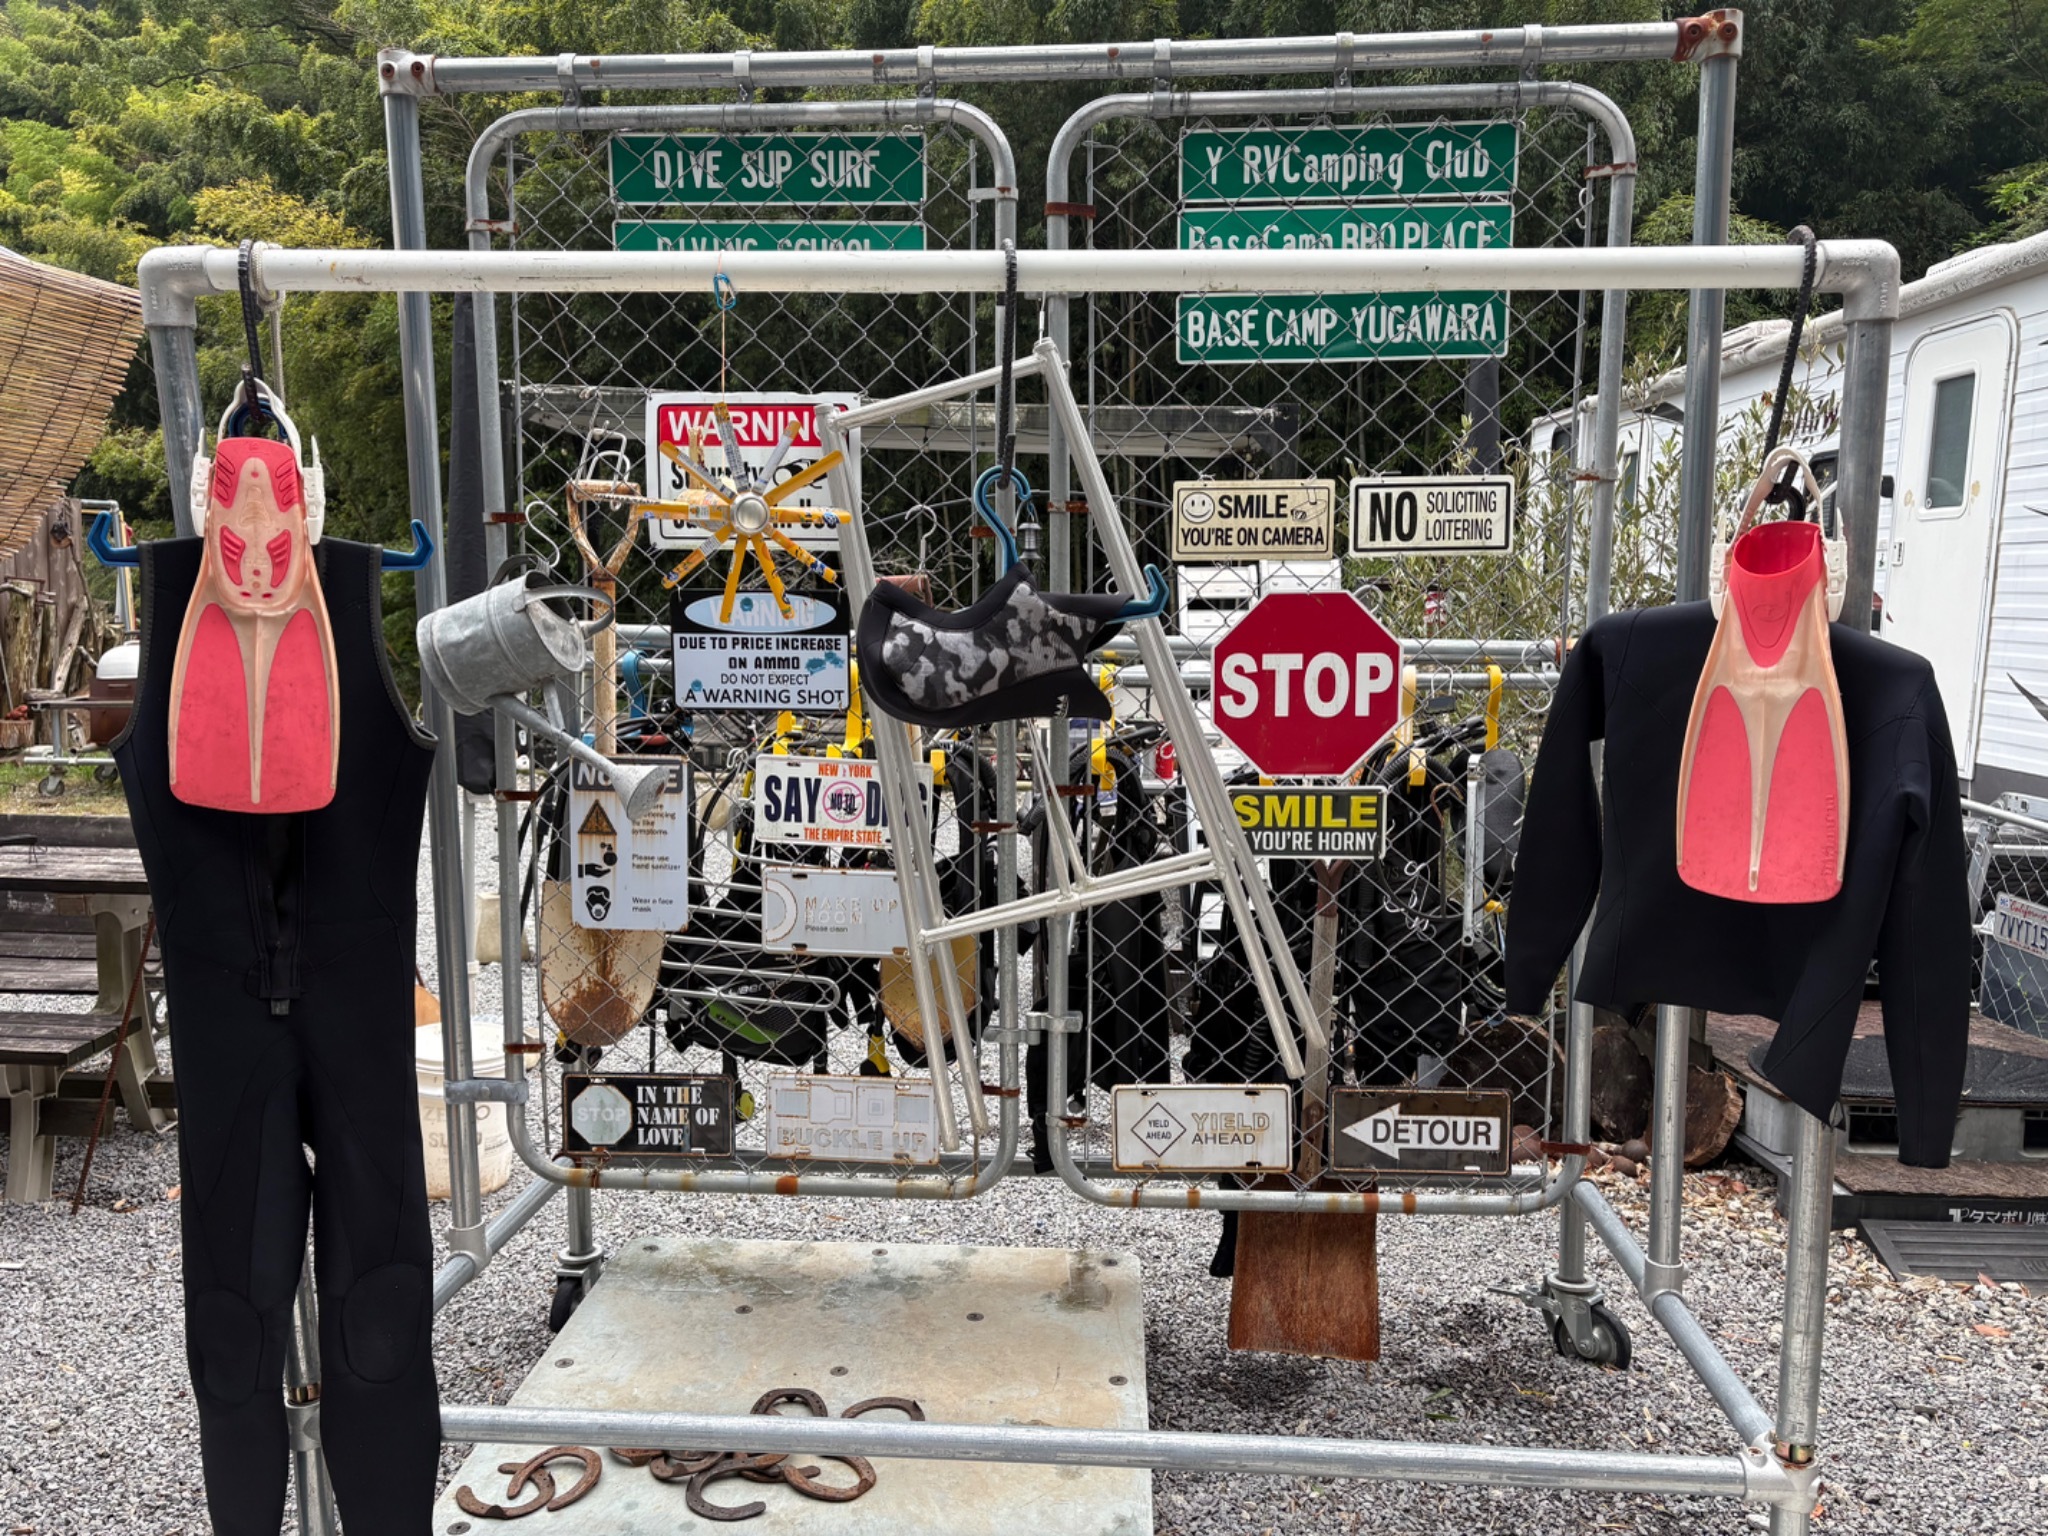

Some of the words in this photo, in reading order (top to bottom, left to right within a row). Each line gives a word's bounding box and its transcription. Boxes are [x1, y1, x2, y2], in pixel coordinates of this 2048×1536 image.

[653, 149, 724, 190] DIVE
[741, 150, 793, 189] SUP
[810, 149, 880, 189] SURF
[1206, 145, 1223, 185] Y
[1426, 138, 1490, 179] Club
[1187, 309, 1260, 348] BASE
[1266, 307, 1338, 346] CAMP
[1350, 302, 1498, 344] YUGAWARA
[668, 410, 823, 442] WARNIN
[1217, 493, 1289, 520] SMILE
[1426, 490, 1497, 514] SOLICITING
[1368, 490, 1418, 542] NO
[1181, 527, 1233, 547] YOU'RE
[1237, 527, 1258, 546] ON
[1262, 526, 1325, 546] CAMERA
[1425, 518, 1493, 542] LOITERING
[709, 598, 817, 628] WARNING
[679, 636, 706, 650] DUE
[712, 637, 728, 650] TO
[731, 637, 773, 651] PRICE
[775, 637, 842, 651] INCREASE
[728, 656, 748, 670] ON
[754, 656, 800, 670] AMMO
[720, 673, 738, 685] DO
[741, 673, 765, 685] NOT
[768, 674, 810, 686] EXPECT
[1219, 651, 1394, 719] STOP
[684, 689, 697, 703] A
[701, 689, 791, 704] WARNING
[796, 689, 845, 705] SHOT
[818, 762, 839, 777] NEW
[848, 764, 872, 778] YORK
[764, 774, 822, 823] SAY
[1233, 794, 1378, 829] SMILE
[804, 827, 821, 841] THE
[822, 828, 854, 842] EMPIRE
[856, 830, 882, 844] STATE
[1251, 831, 1313, 851] YOU'RE
[1317, 831, 1378, 851] HORNY
[632, 854, 657, 862] Please
[658, 897, 674, 905] face
[805, 896, 862, 911] MAKE
[872, 897, 898, 913] UP
[804, 910, 863, 925] ROOM
[636, 1085, 658, 1104] IN
[663, 1086, 702, 1105] THE
[577, 1107, 627, 1122] STOP
[636, 1106, 690, 1125] NAME
[695, 1107, 719, 1126] OF
[1148, 1119, 1169, 1128] YIELD
[1191, 1112, 1270, 1132] YIELD
[637, 1127, 683, 1146] LOVE
[777, 1126, 883, 1151] BUCKLE
[892, 1131, 928, 1152] UP
[1146, 1130, 1172, 1140] AHEAD
[1191, 1132, 1256, 1145] AHEAD
[1371, 1118, 1492, 1146] DETOUR
